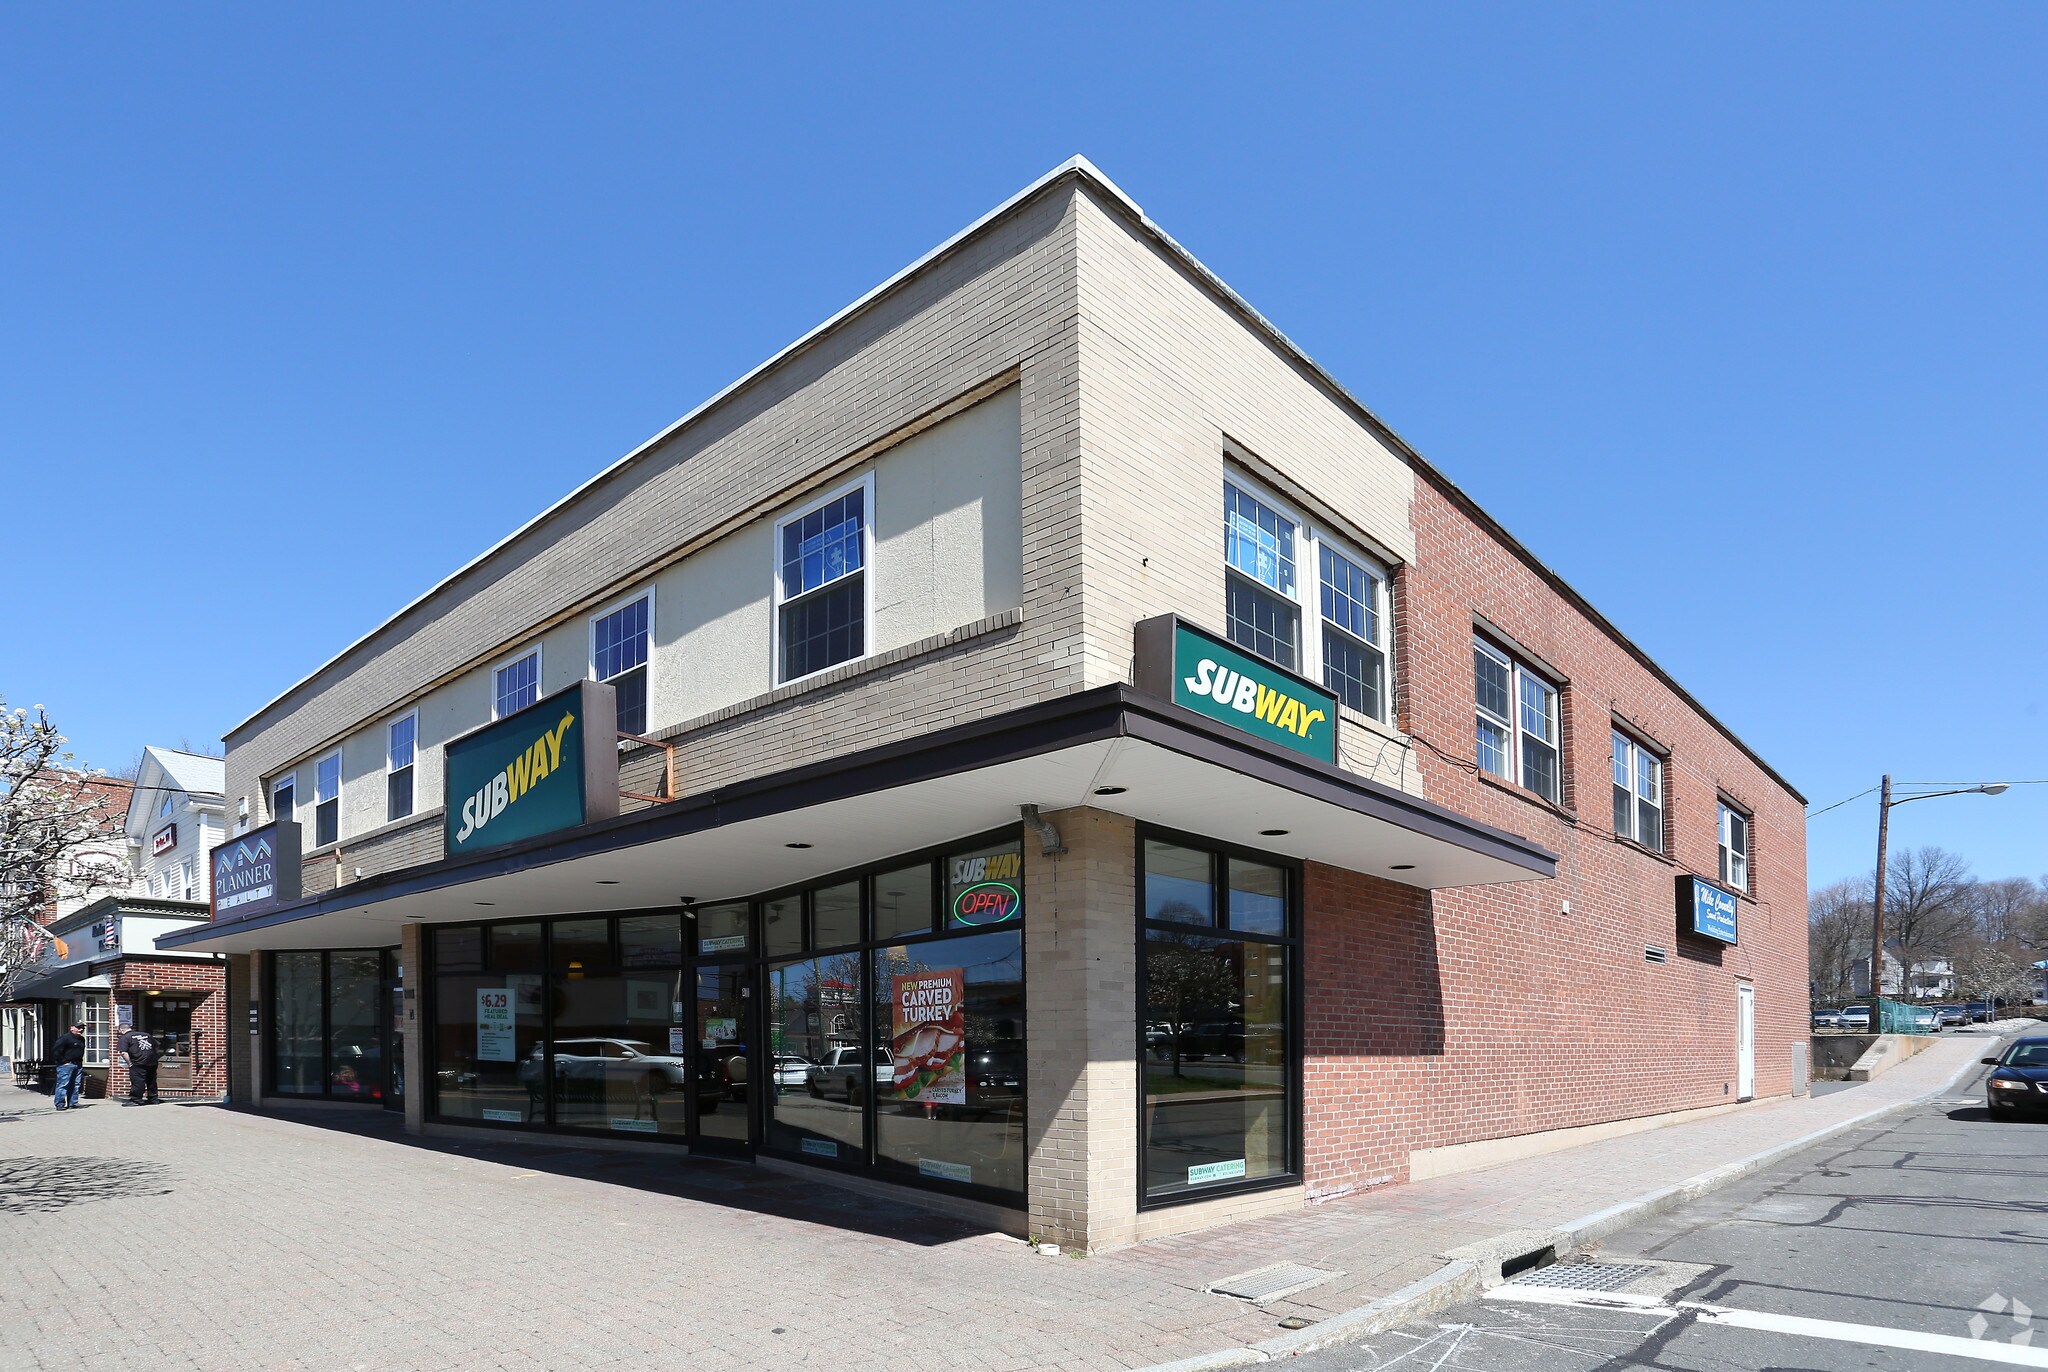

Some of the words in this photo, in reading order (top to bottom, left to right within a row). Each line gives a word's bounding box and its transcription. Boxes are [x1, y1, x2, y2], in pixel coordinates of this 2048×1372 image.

[1184, 658, 1326, 738] SUBWAY
[456, 712, 575, 844] SUBWAY
[216, 863, 272, 896] PLANNER
[952, 853, 1021, 885] SUBWAY
[217, 886, 272, 909] REALTY
[962, 892, 1010, 917] OPEN
[901, 981, 918, 991] NEW
[918, 978, 952, 990] PREMIUM
[481, 994, 507, 1008] $6.29
[901, 987, 953, 1007] CARVED
[902, 1004, 953, 1023] TURKEY
[1190, 1166, 1216, 1177] SUBWAY
[1216, 1161, 1244, 1173] CATERING
